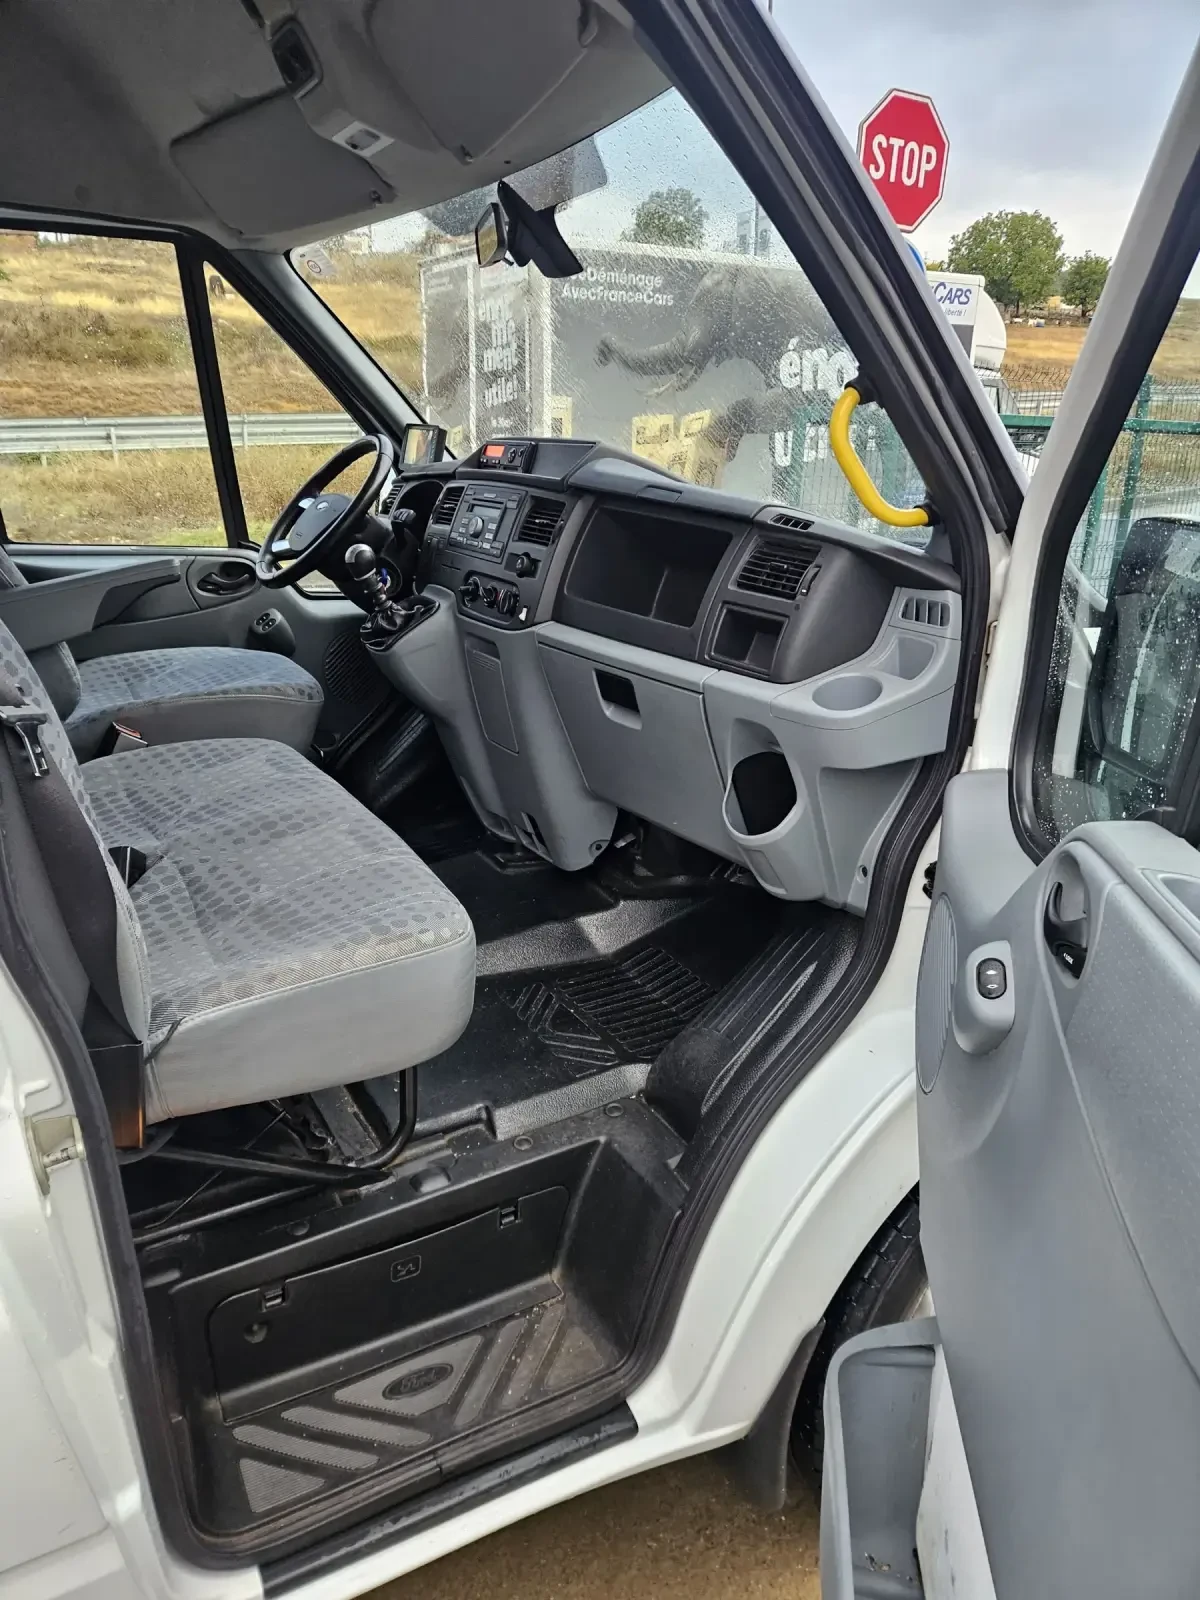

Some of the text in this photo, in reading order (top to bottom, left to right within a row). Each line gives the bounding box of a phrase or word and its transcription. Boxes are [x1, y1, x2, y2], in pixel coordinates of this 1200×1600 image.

[869, 133, 937, 188] STOP
[569, 266, 664, 291] eDéménage
[561, 282, 674, 306] AvecFranceCars
